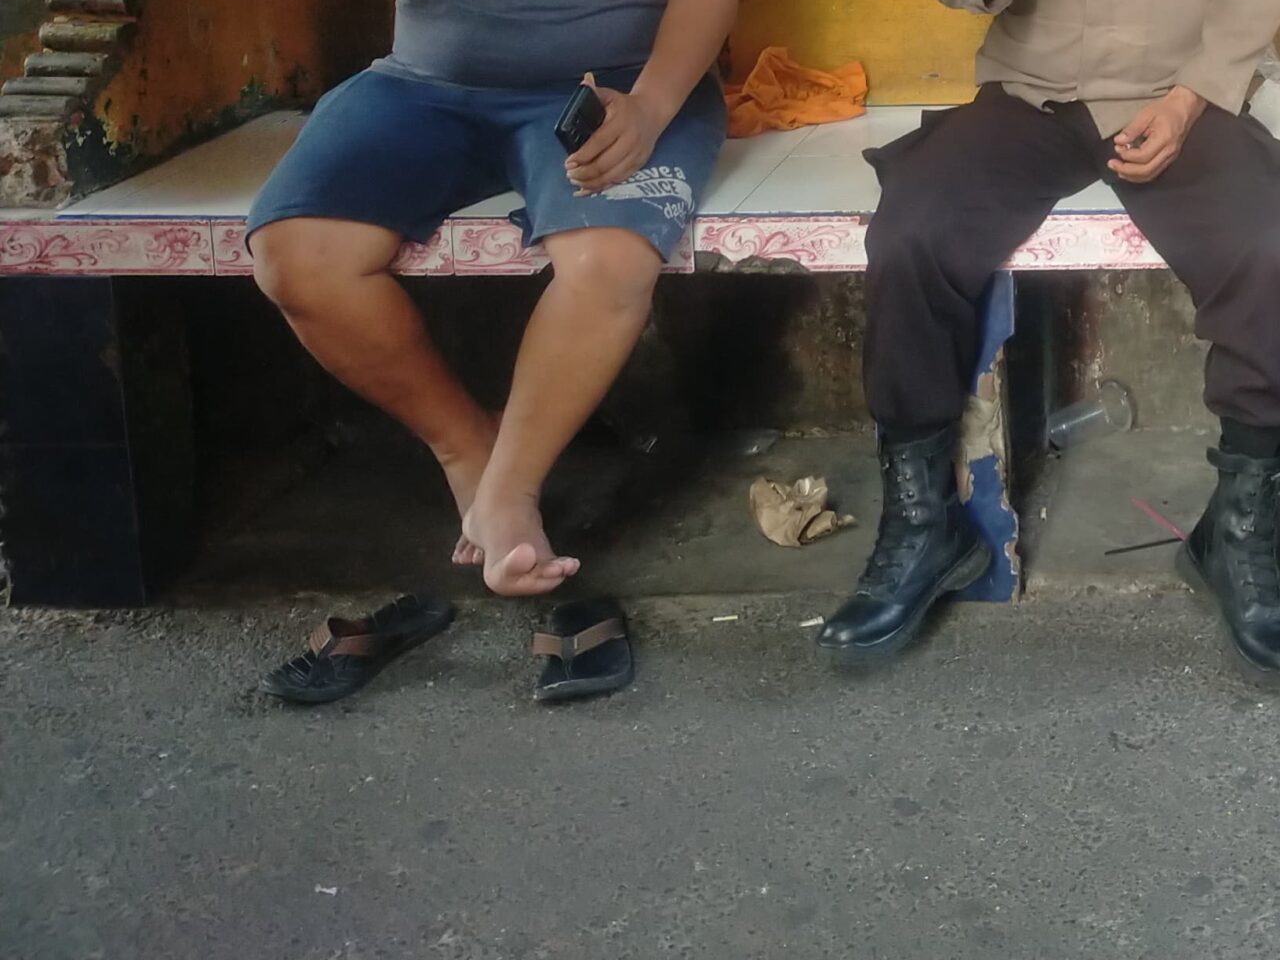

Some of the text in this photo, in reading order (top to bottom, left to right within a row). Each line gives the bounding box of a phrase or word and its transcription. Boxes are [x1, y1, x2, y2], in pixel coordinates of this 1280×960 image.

[629, 166, 686, 181] ave a
[636, 180, 680, 195] NICE
